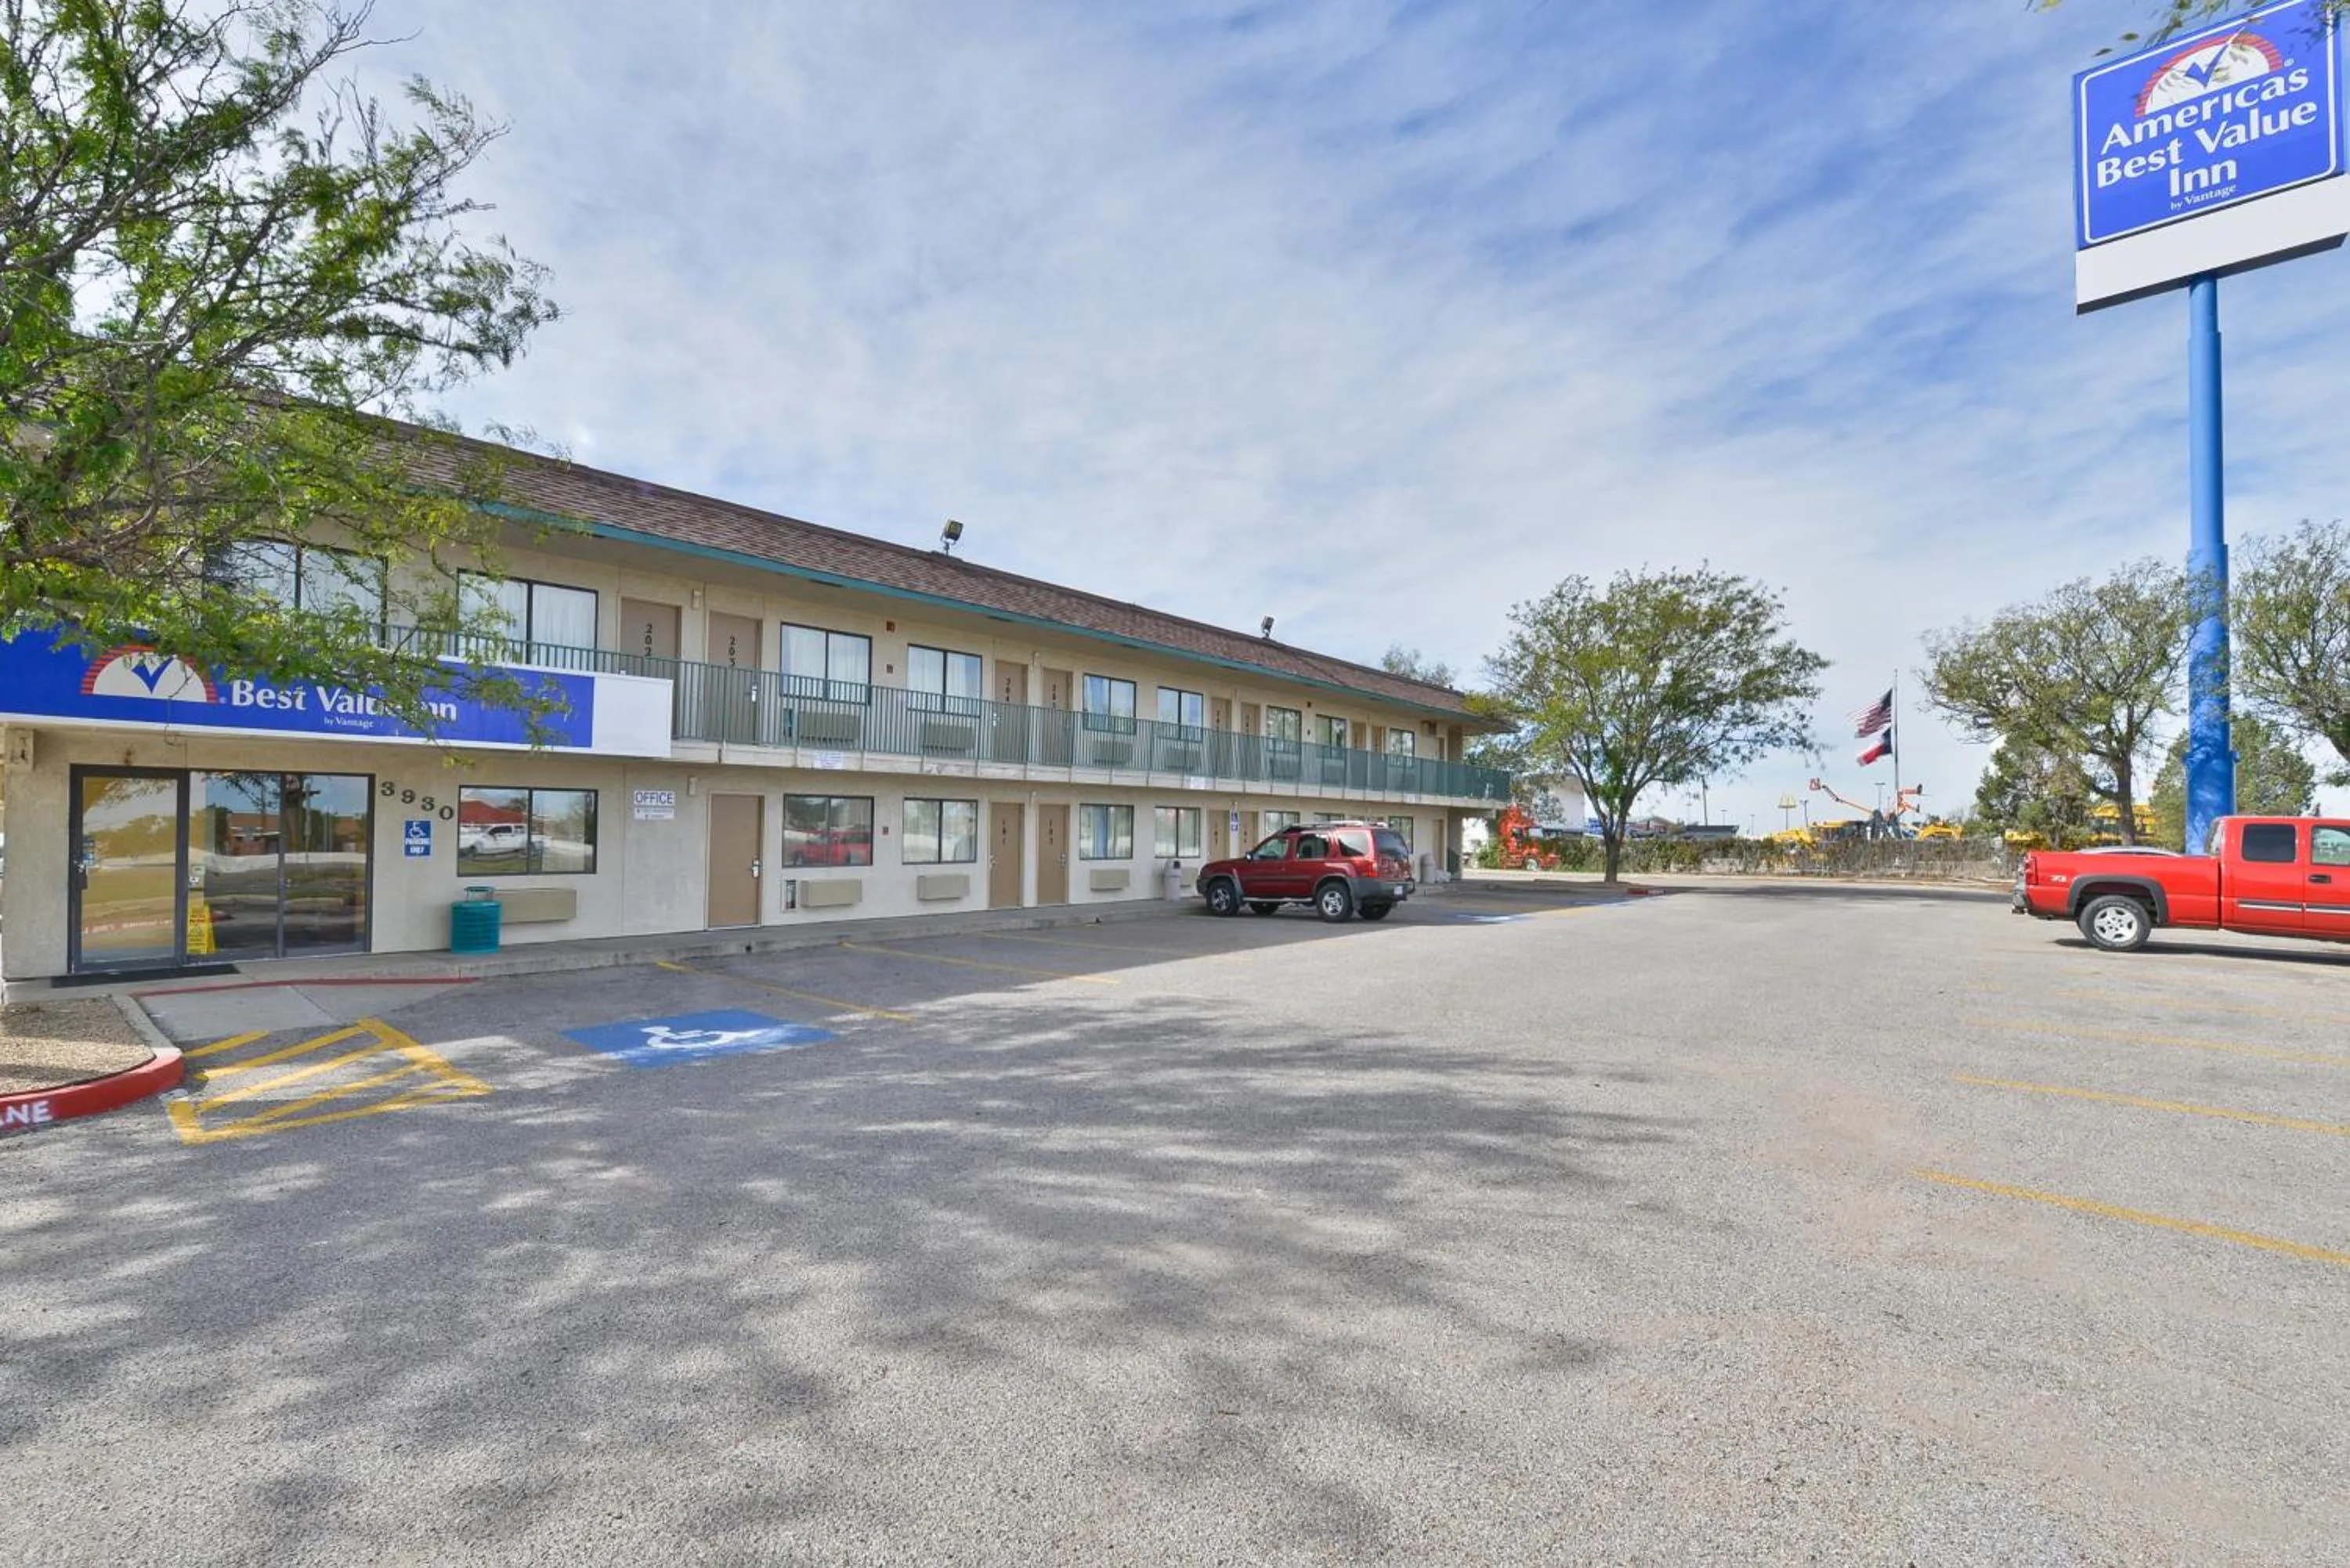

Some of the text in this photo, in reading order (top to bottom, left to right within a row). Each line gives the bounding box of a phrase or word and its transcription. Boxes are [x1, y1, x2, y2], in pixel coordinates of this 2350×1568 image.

[2101, 67, 2309, 155] Americas
[2096, 100, 2317, 189] Best Value
[2169, 159, 2237, 197] Inn
[2170, 183, 2237, 211] by Vantage
[232, 679, 307, 710] Best
[381, 782, 454, 821] 3930
[635, 792, 674, 804] OFFICE
[0, 1100, 52, 1125] NE
